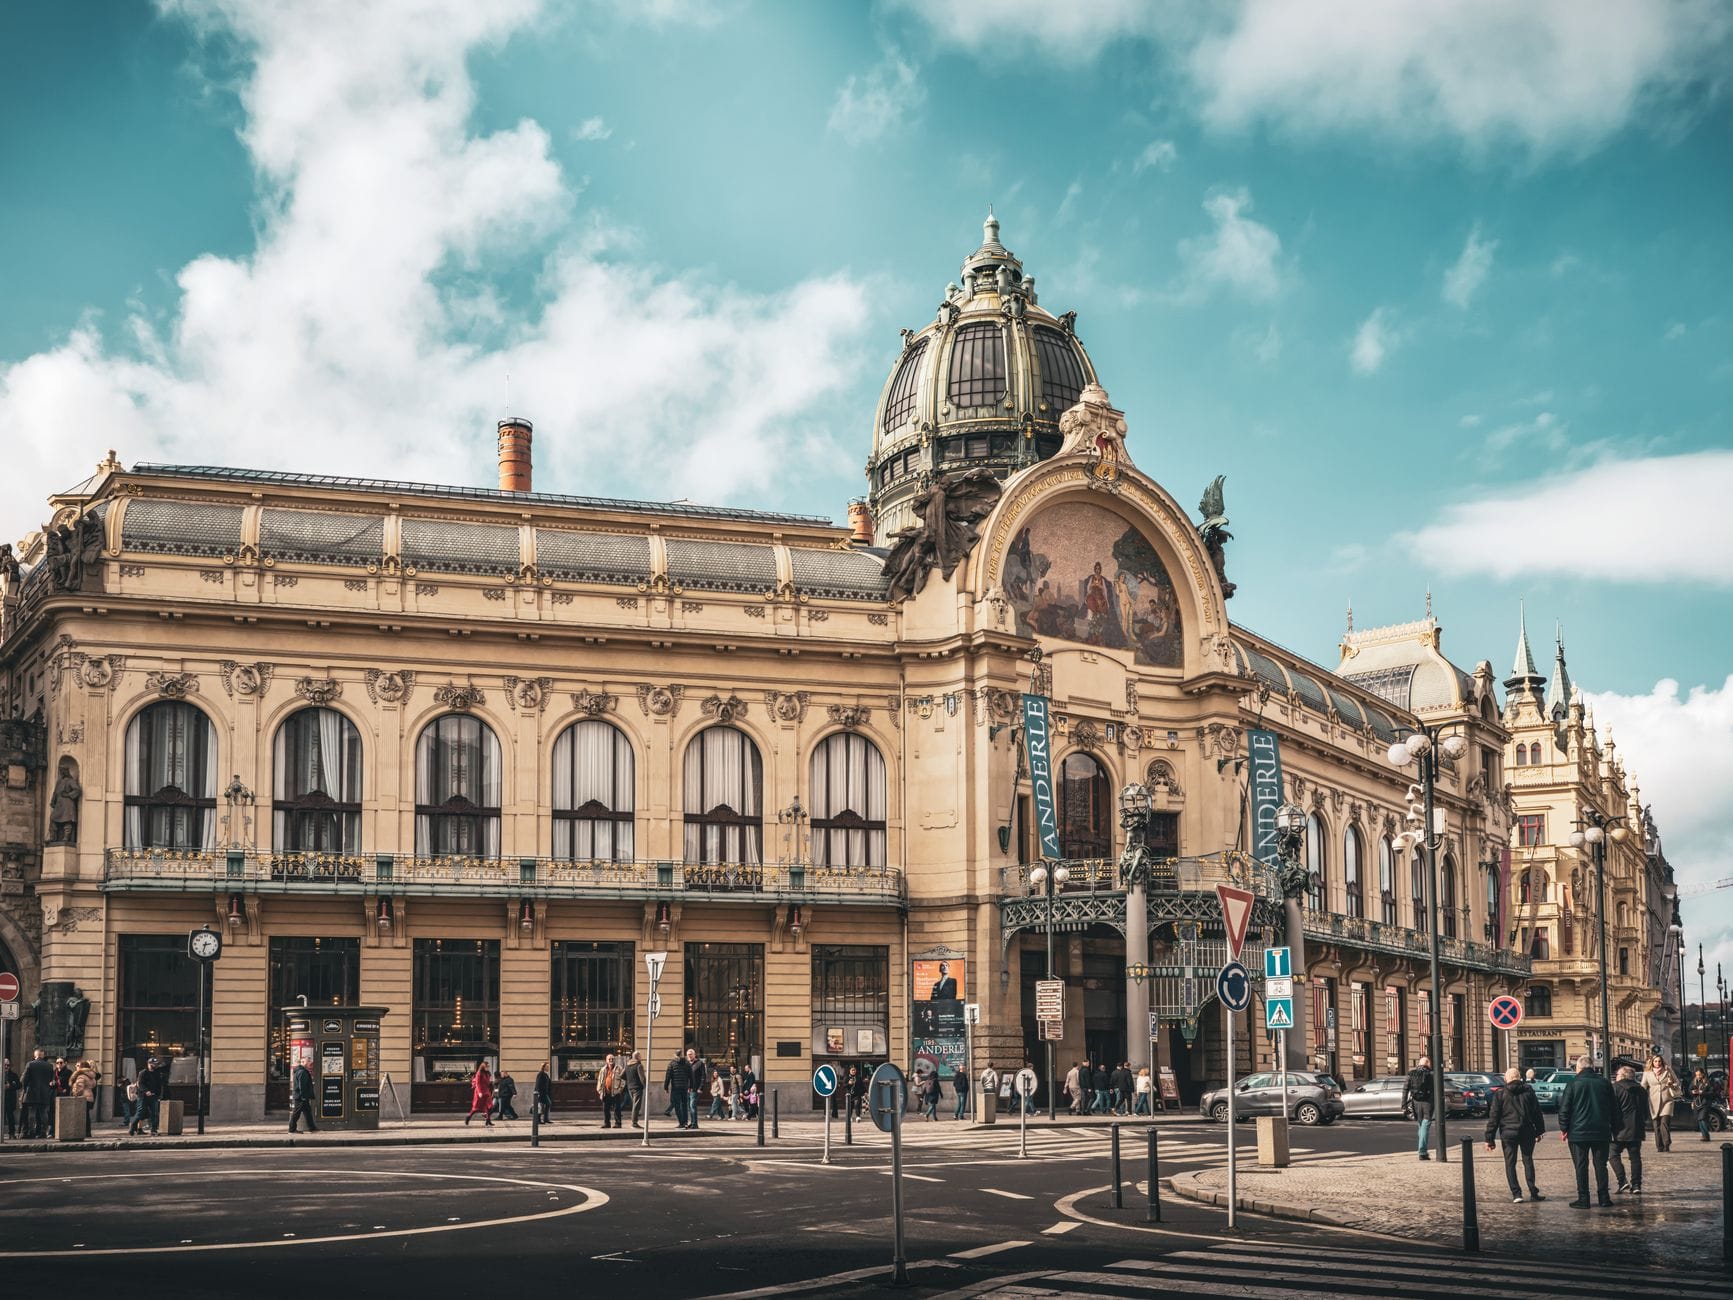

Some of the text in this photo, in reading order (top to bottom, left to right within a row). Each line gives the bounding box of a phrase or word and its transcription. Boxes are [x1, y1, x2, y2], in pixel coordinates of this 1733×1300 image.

[988, 554, 998, 581] ZDAR
[1027, 701, 1058, 852] ANDERLE
[1253, 735, 1280, 870] ANDERLE
[1151, 1015, 1157, 1028] P
[917, 1044, 966, 1054] ANDERLE
